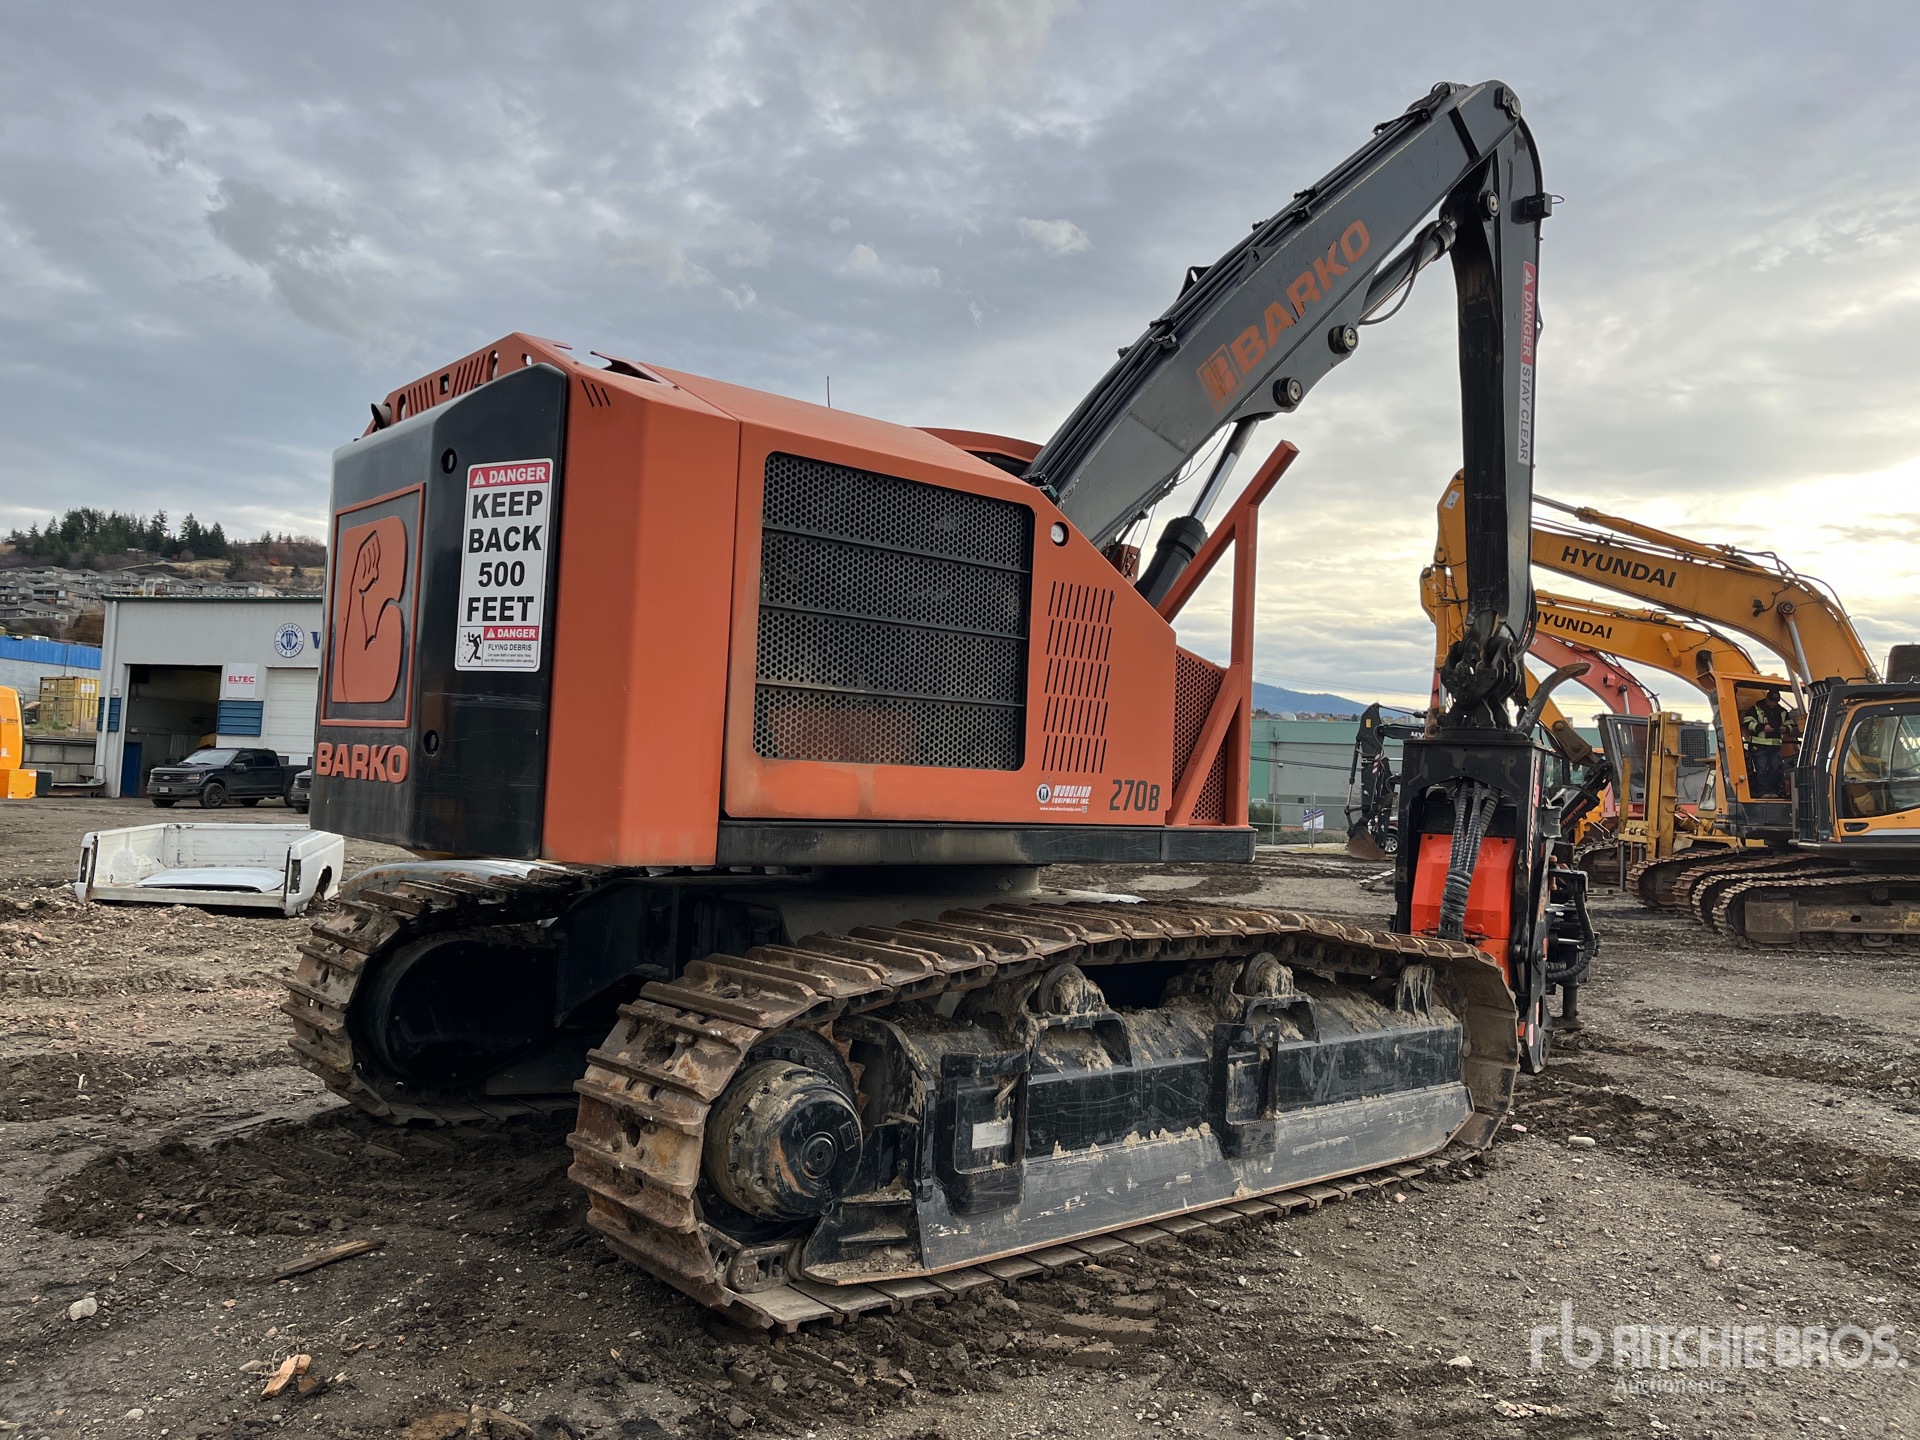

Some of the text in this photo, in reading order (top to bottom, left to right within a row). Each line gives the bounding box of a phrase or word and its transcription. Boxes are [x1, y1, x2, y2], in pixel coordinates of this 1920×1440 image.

[1230, 219, 1371, 375] BARKO
[1519, 290, 1533, 460] DANGER STAY CLEAR
[488, 466, 546, 484] DANGER
[472, 490, 543, 519] KEEP
[468, 525, 543, 554] BACK
[478, 561, 525, 588] 500
[1561, 545, 1677, 589] HYUNDAI
[467, 596, 534, 622] FEET
[488, 643, 532, 651] FLYING DEBRIS
[497, 628, 536, 638] DANGER
[228, 675, 255, 683] ELTEC
[316, 742, 409, 784] BARKO
[1053, 784, 1092, 798] WOODLAND
[1109, 779, 1161, 812] 270B
